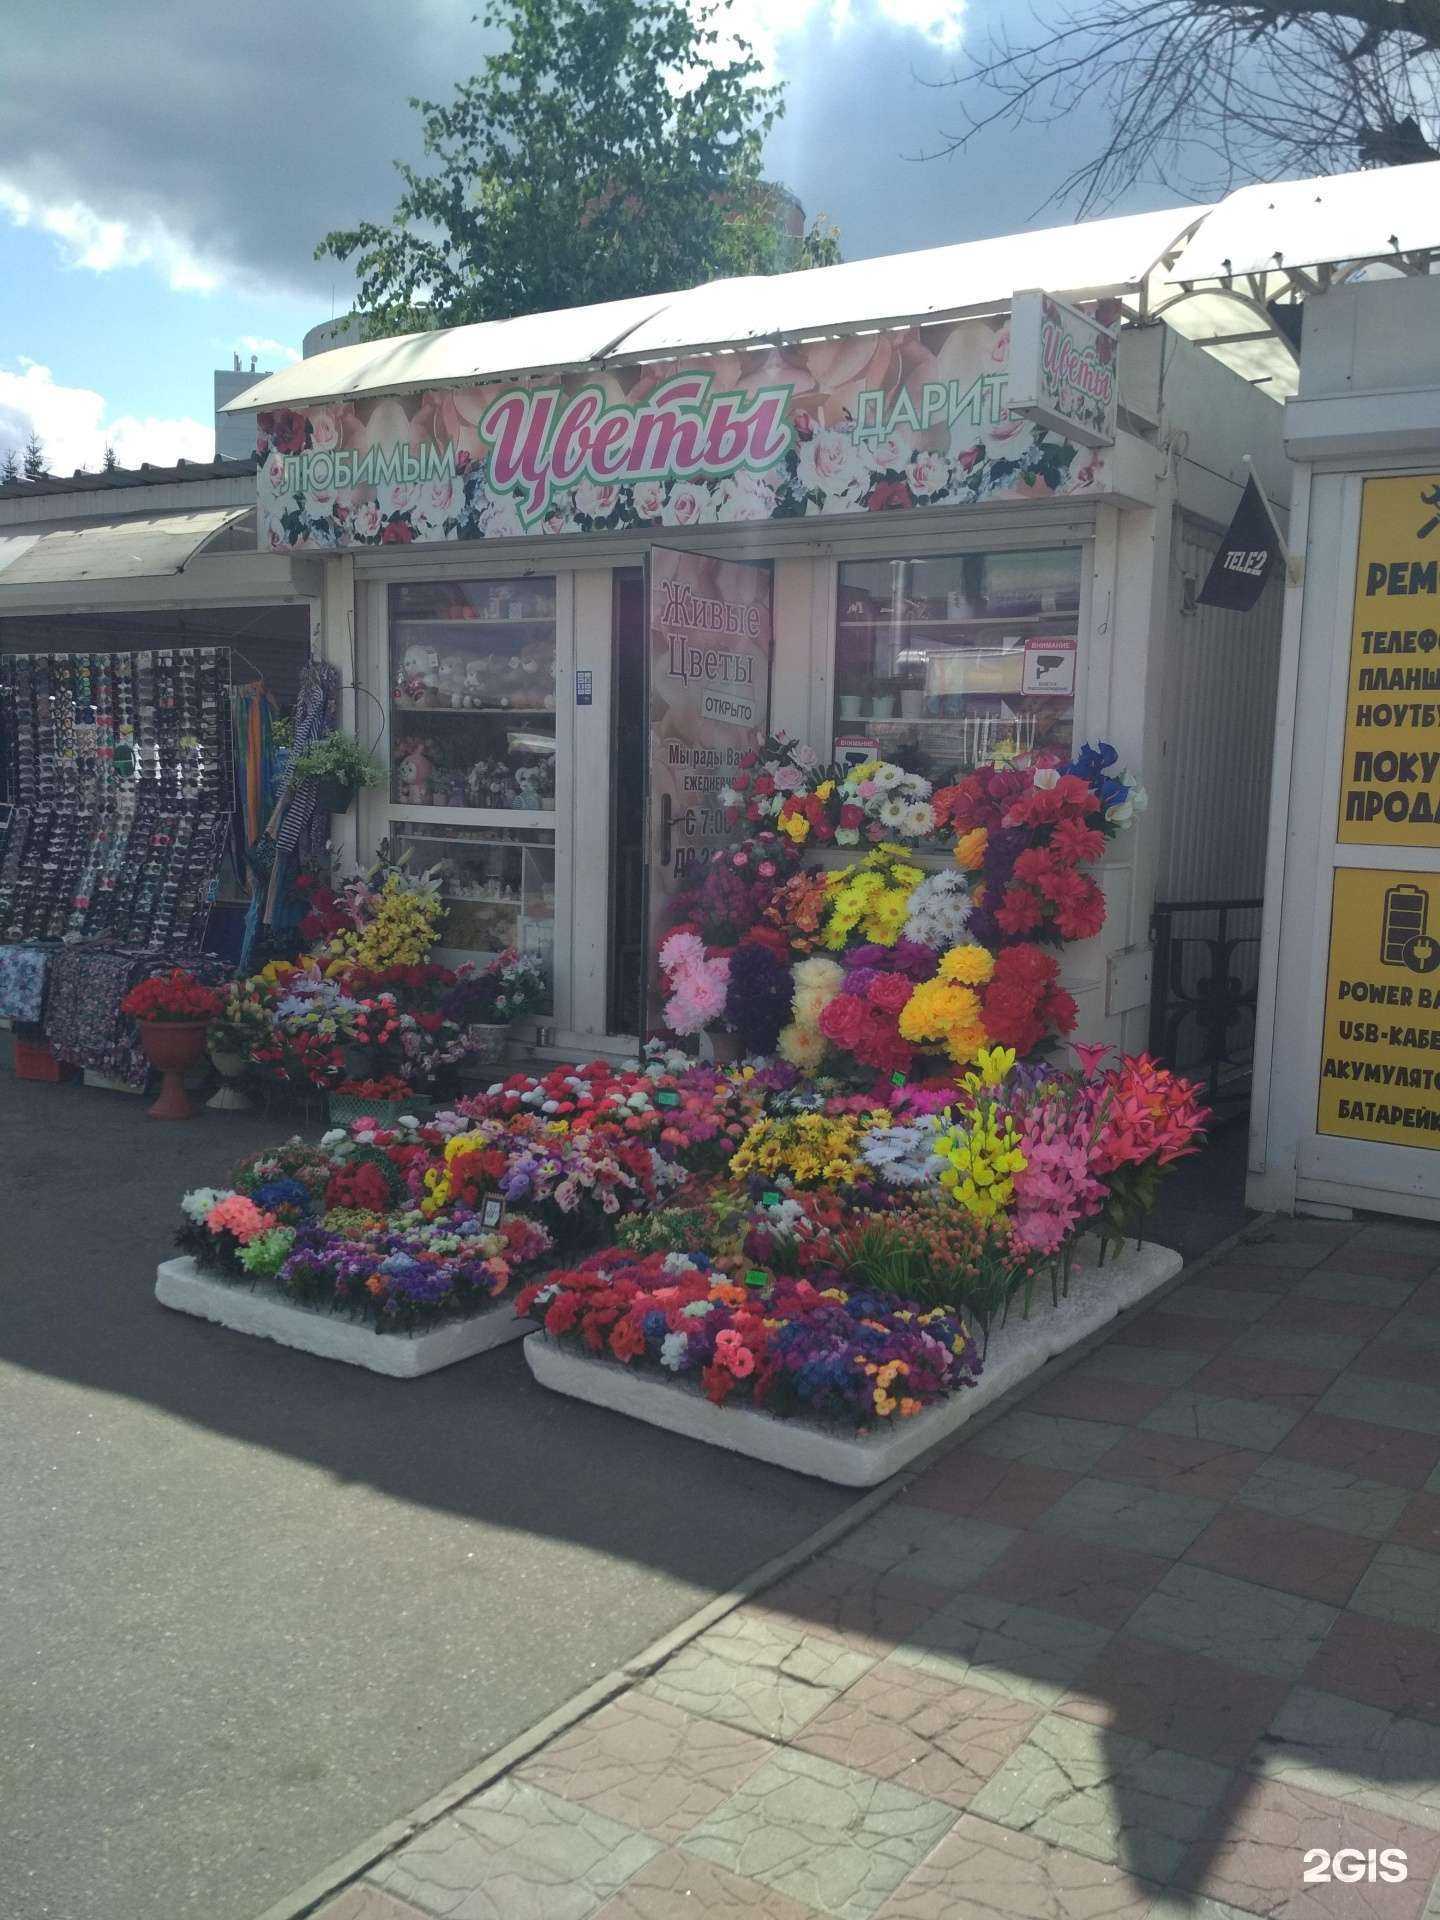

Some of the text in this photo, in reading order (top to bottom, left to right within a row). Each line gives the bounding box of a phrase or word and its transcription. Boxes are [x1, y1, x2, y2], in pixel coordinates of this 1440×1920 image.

[1041, 320, 1113, 404] Цветы
[276, 372, 1024, 525] ЛЮБИМЫМ Цветы ДАРИТ
[1223, 550, 1267, 577] TELE2
[1366, 560, 1440, 596] РЕМ
[661, 580, 760, 638] Живые
[1361, 628, 1440, 655] ТЕЛЕФ
[667, 633, 755, 688] Цветы
[705, 697, 752, 720] ОТКРЫТО
[1356, 703, 1440, 728] НОУТБ
[669, 744, 690, 765] Мы
[693, 748, 722, 769] рады
[1353, 750, 1440, 784] ПОКУ
[1338, 980, 1413, 1007] POWER
